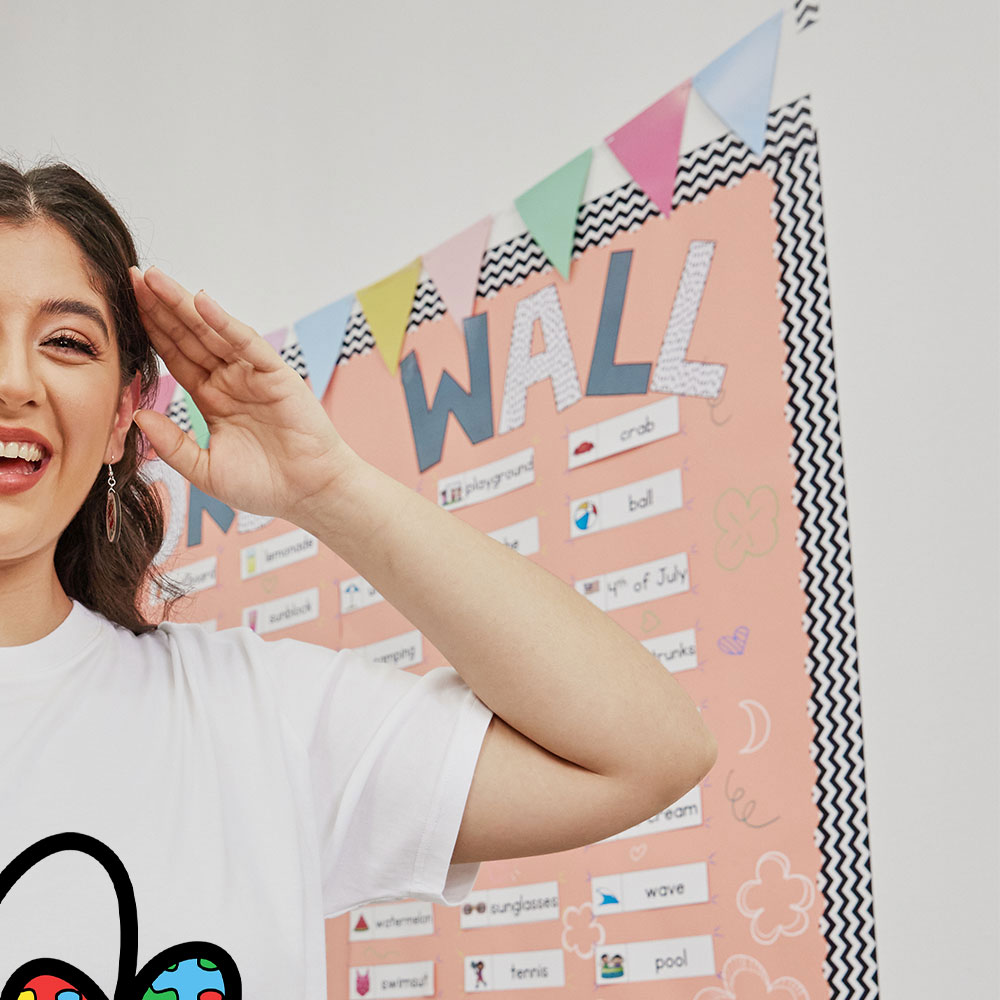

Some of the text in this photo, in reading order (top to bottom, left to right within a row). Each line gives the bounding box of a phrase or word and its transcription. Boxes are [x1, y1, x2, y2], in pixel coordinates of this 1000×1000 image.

[400, 240, 728, 473] WALL
[619, 416, 655, 441] crab
[465, 455, 534, 497] playground
[628, 487, 654, 512] ball
[265, 538, 313, 562] lemonade
[633, 572, 651, 592] of
[656, 564, 688, 587] July
[269, 602, 312, 623] sunblock
[643, 882, 686, 900] wave
[490, 896, 559, 917] sunglasses
[375, 912, 433, 929] watermelon
[510, 964, 550, 980] tennis
[655, 948, 688, 974] pool
[381, 974, 429, 991] swimsuit
